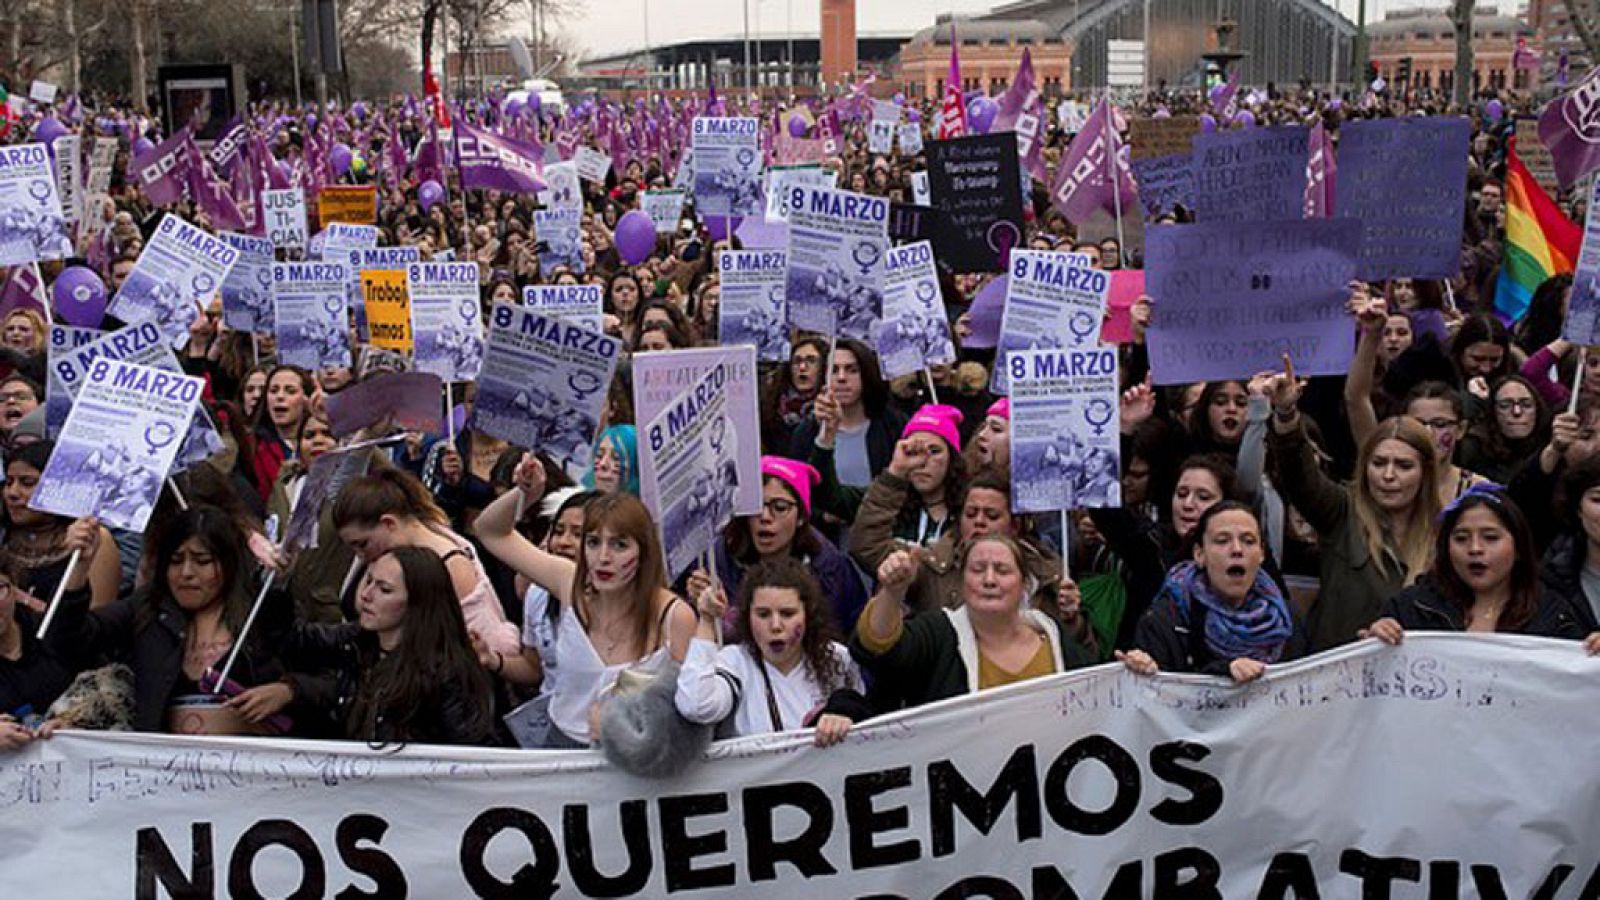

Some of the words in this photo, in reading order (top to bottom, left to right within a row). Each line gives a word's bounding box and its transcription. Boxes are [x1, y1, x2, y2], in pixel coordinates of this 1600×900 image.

[707, 118, 756, 134] MARZO
[0, 147, 45, 165] ARZO
[265, 191, 302, 209] JUS-
[791, 187, 804, 208] 8
[811, 190, 885, 221] MARZO
[161, 218, 175, 234] 8
[177, 226, 237, 265] MARZO
[350, 250, 361, 265] 8
[364, 249, 418, 264] MARZO
[722, 254, 732, 270] 8
[738, 253, 786, 270] MARZ
[887, 244, 930, 270] ARZO
[274, 264, 285, 281] 8
[288, 263, 343, 281] MARZO
[410, 264, 421, 282] 8
[425, 264, 476, 282] MARZO
[1013, 257, 1028, 278] 8
[1033, 260, 1106, 293] MARZO
[526, 289, 537, 306] 8
[542, 287, 598, 305] MARZO
[53, 327, 65, 346] 8
[495, 306, 512, 328] 8
[522, 313, 616, 358] MARZO
[58, 361, 76, 382] 8
[78, 322, 159, 373] MARZO
[1011, 355, 1026, 379] 8
[1034, 351, 1115, 378] MARZO
[91, 360, 110, 382] 8
[113, 365, 198, 403] MARZO
[650, 424, 663, 451] 8
[667, 363, 725, 437] MARZO
[134, 812, 407, 900] NOS
[459, 733, 1225, 900] QUEREMOS
